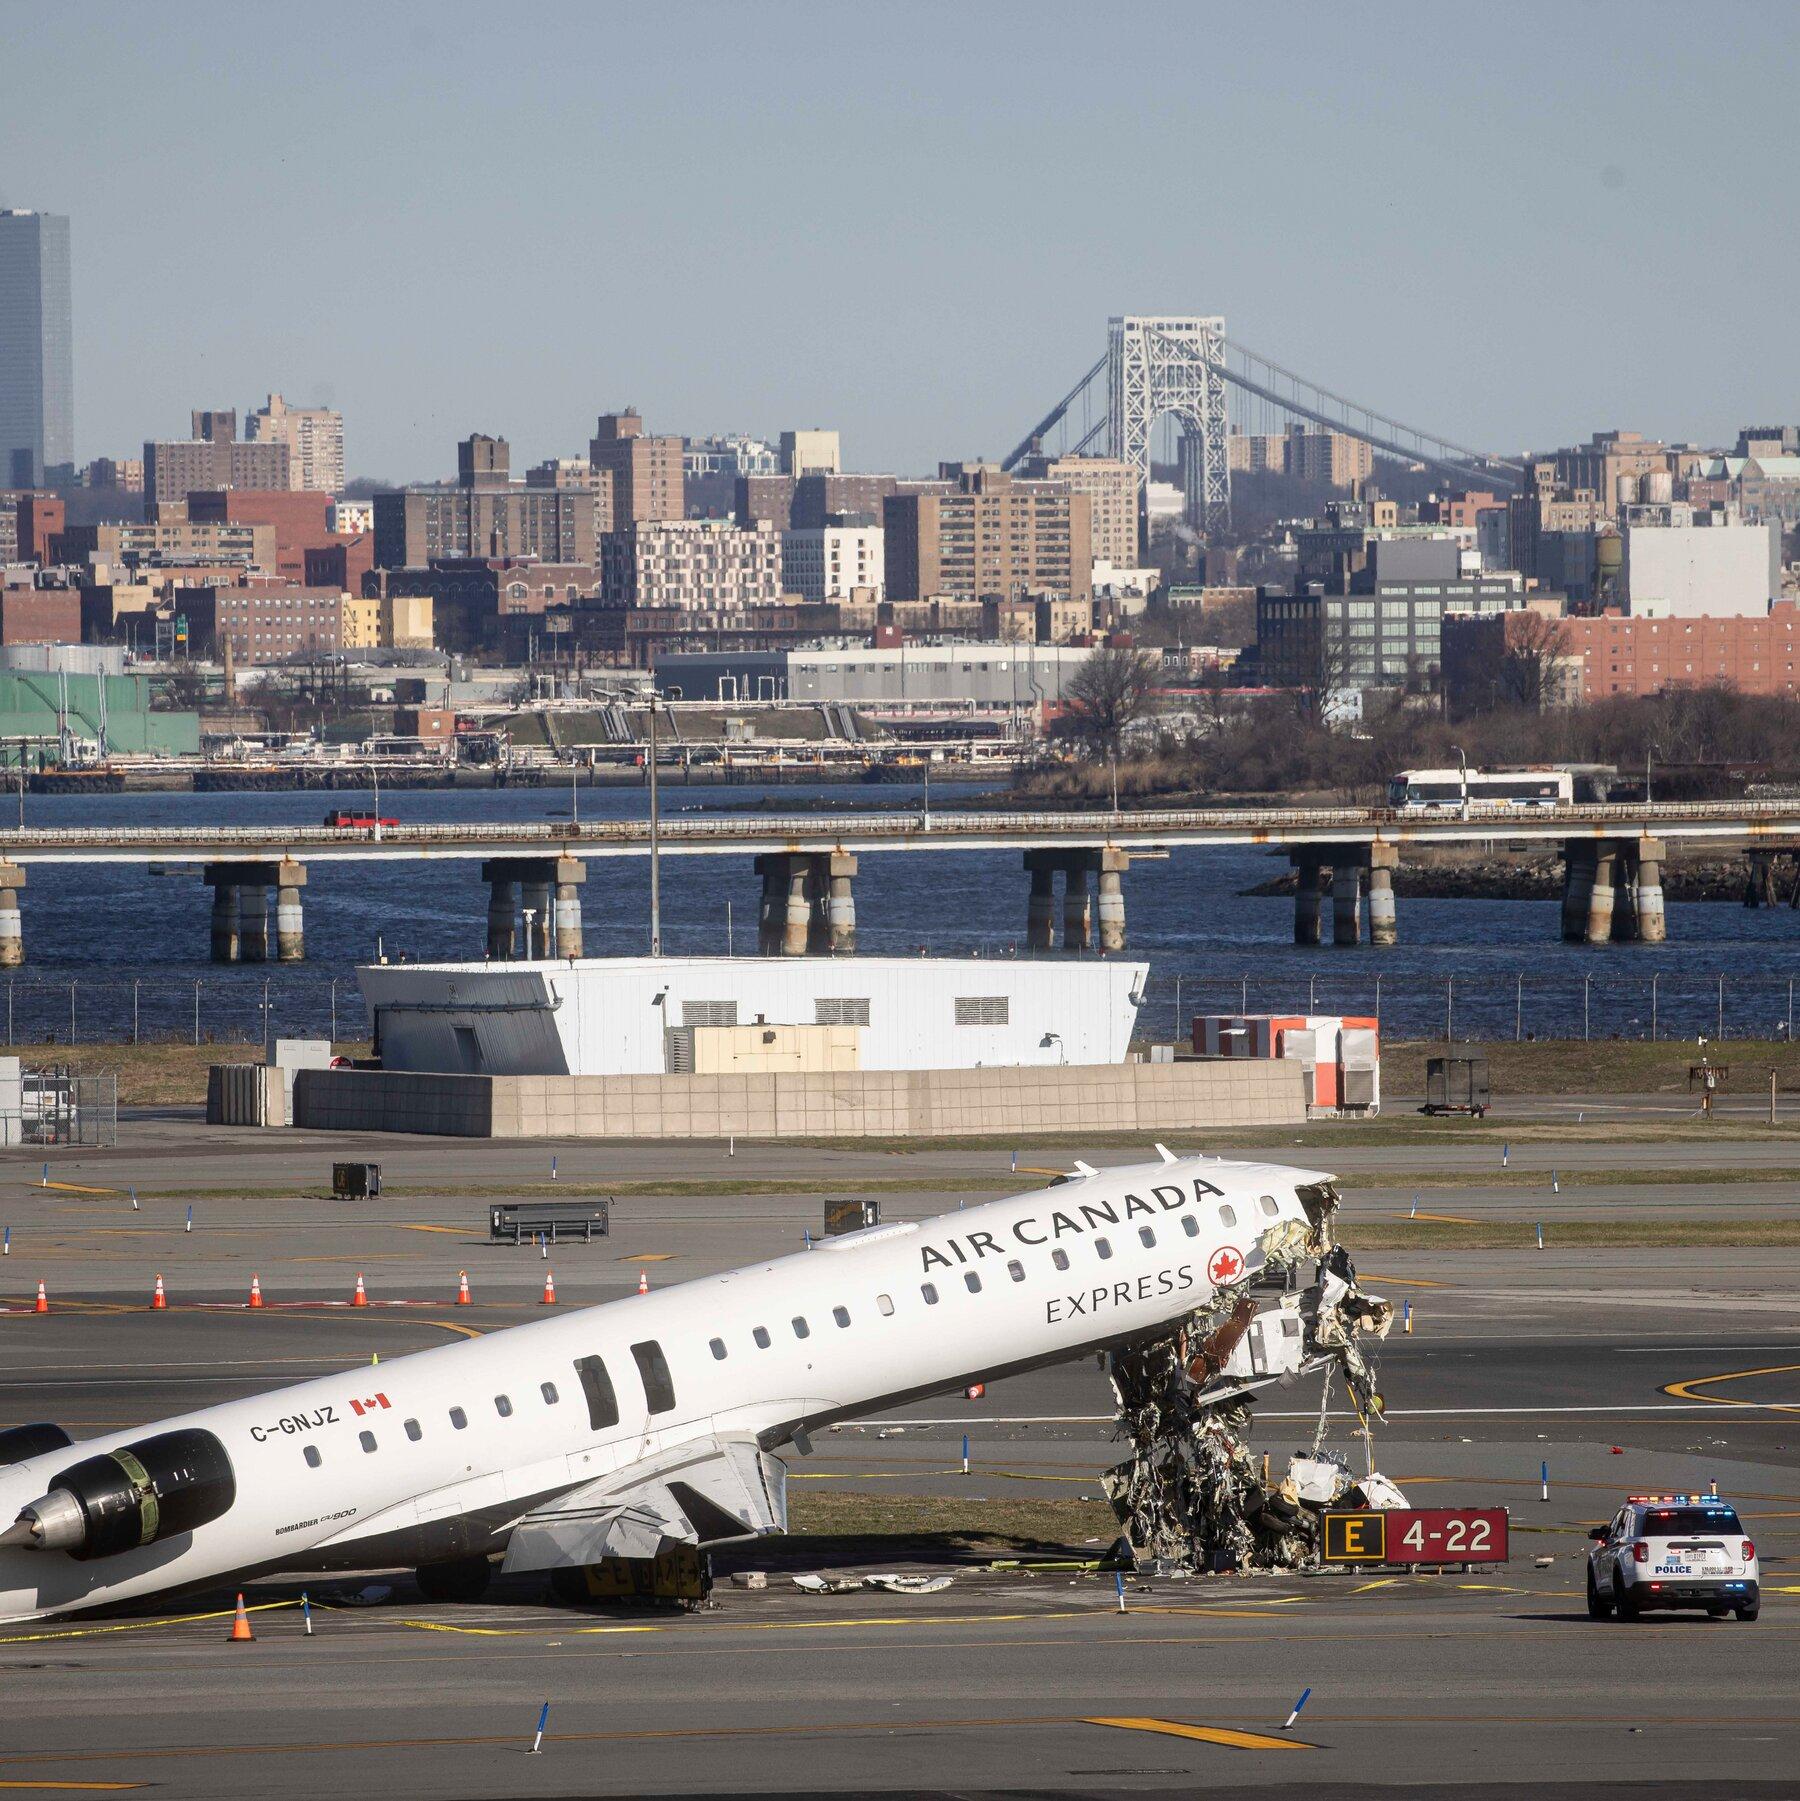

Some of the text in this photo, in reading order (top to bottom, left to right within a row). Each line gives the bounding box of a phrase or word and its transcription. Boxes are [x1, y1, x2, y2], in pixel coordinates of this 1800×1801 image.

[920, 1178, 1226, 1273] AIR CANADA
[1046, 1265, 1194, 1324] EXPRESS
[250, 1406, 340, 1442] C-GNJZ
[275, 1519, 319, 1536] BOMBARDIER
[1345, 1519, 1491, 1553] E 4-22
[1654, 1565, 1692, 1575] POLICE
